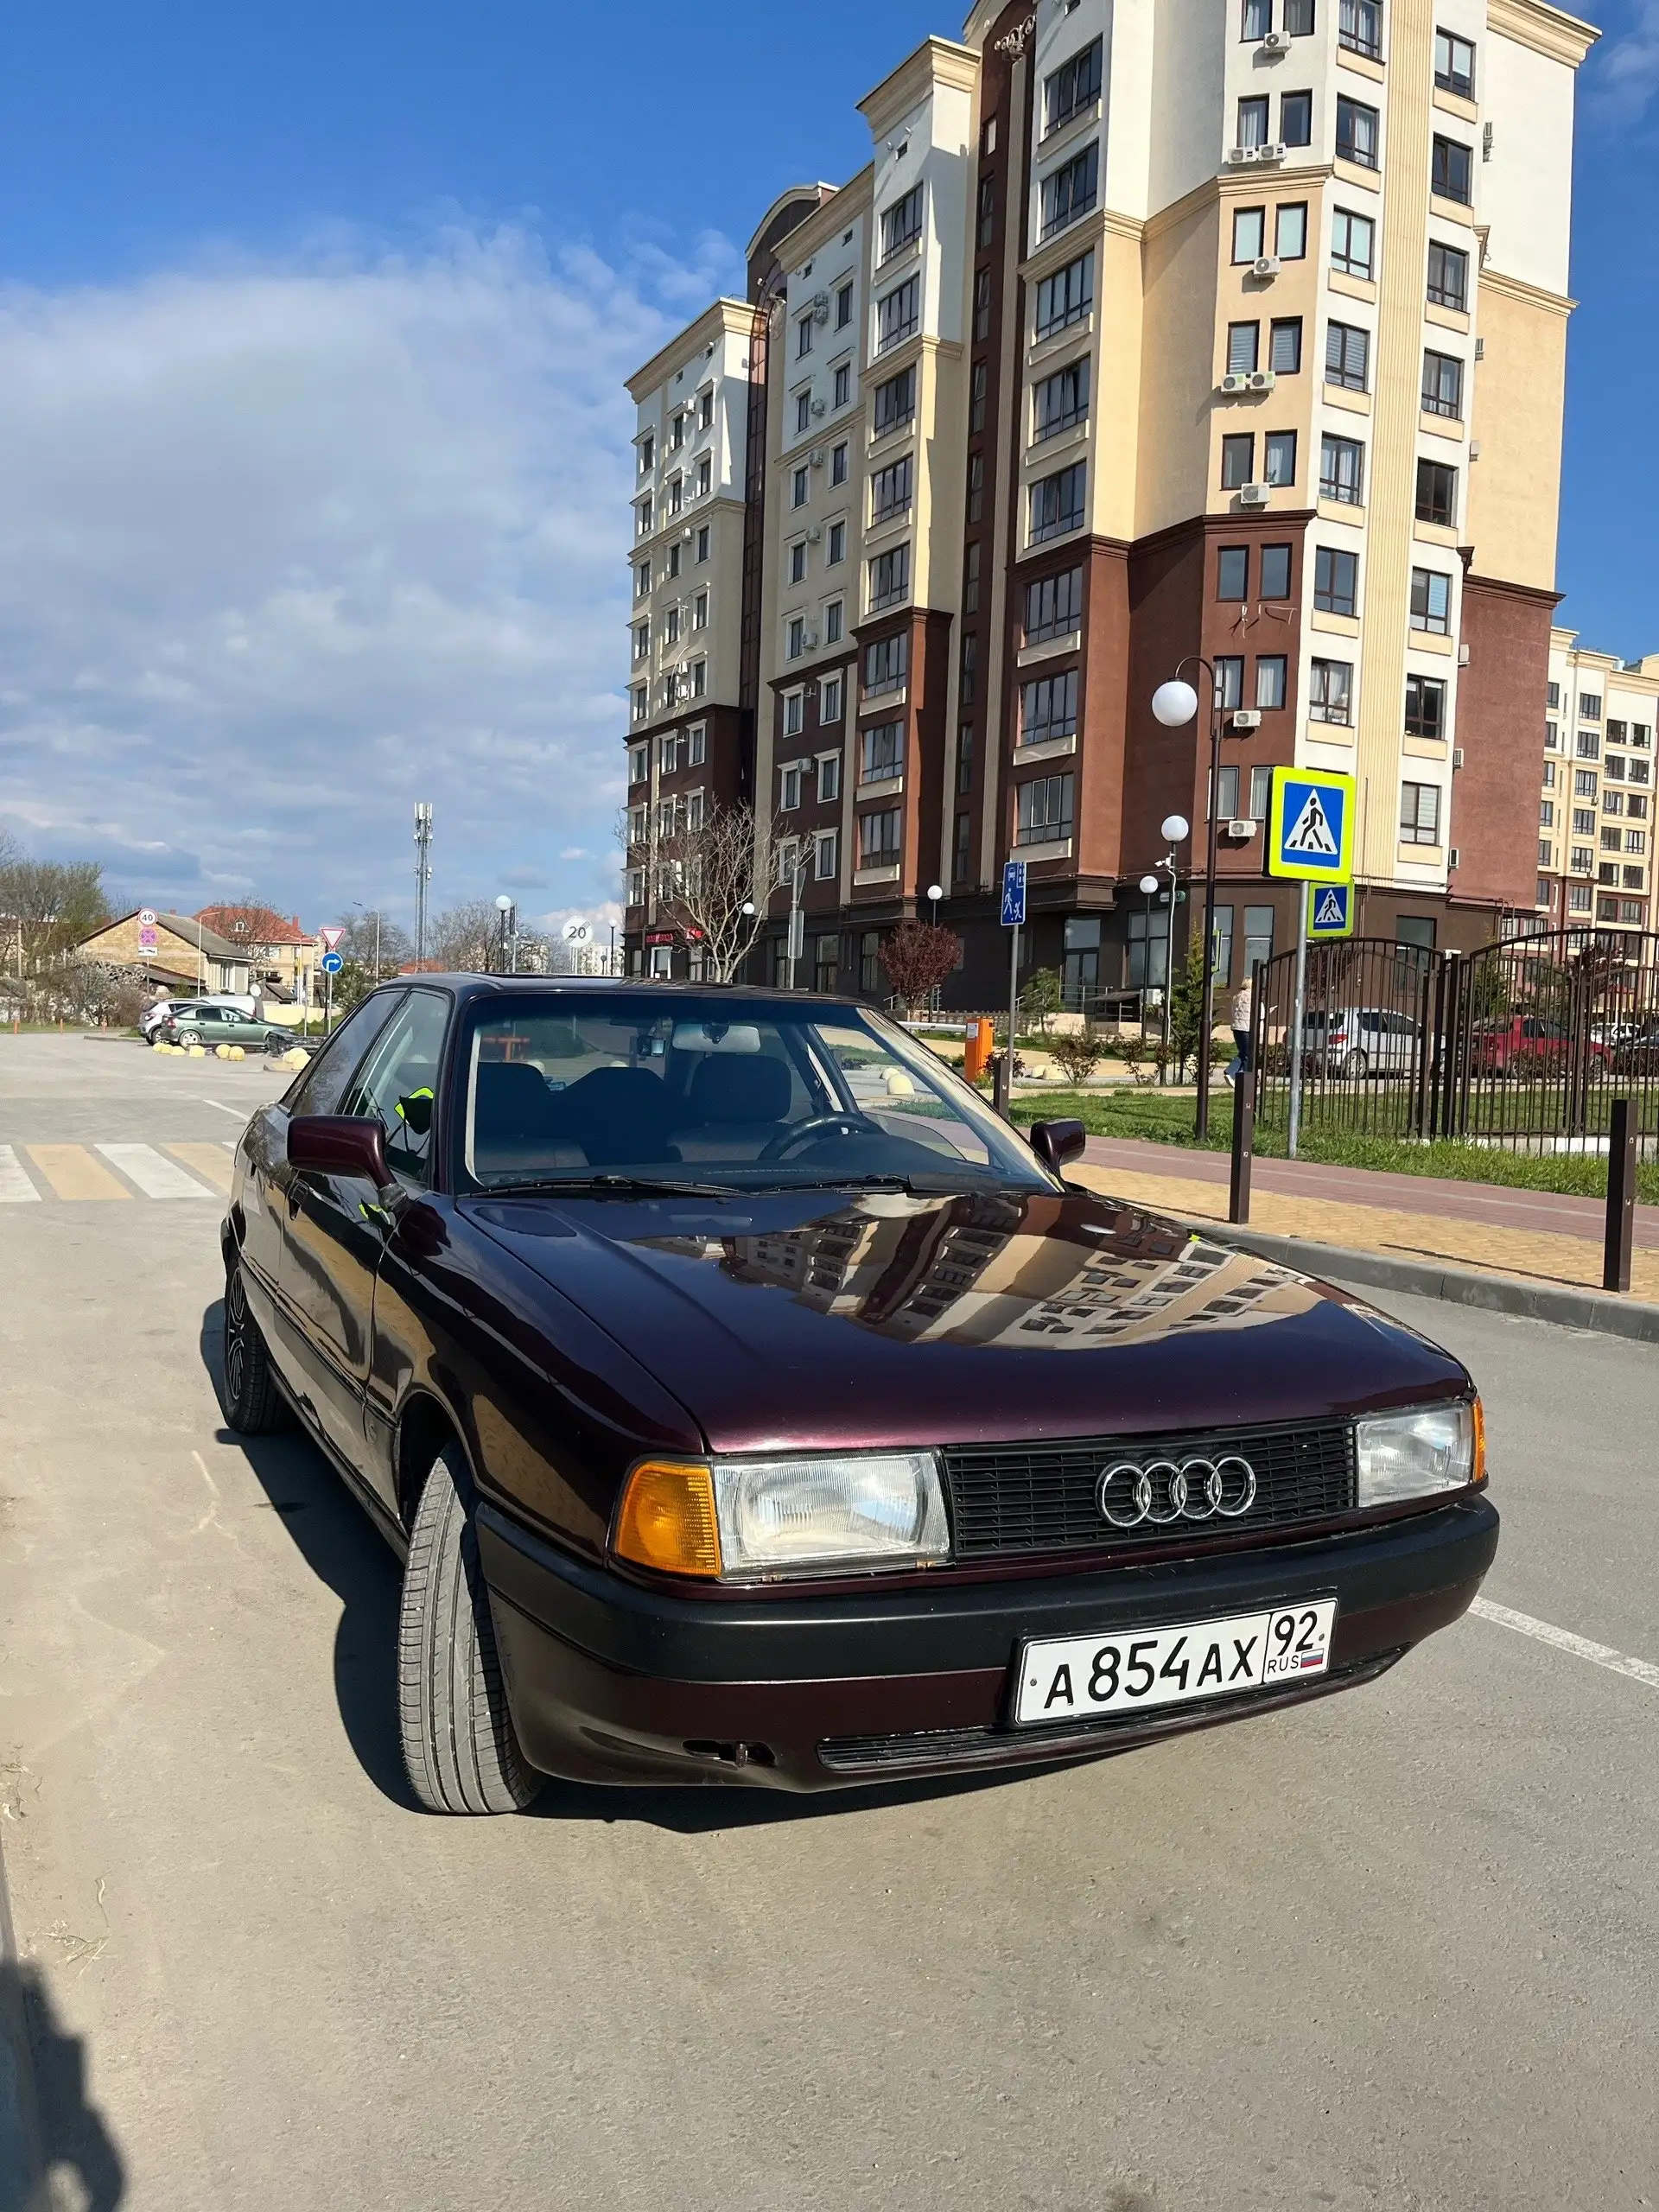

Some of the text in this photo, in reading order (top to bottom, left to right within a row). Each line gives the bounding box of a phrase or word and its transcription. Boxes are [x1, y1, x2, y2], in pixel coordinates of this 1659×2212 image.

[569, 926, 586, 939] 20
[1274, 1611, 1319, 1656] 92
[1267, 1654, 1300, 1675] RUS
